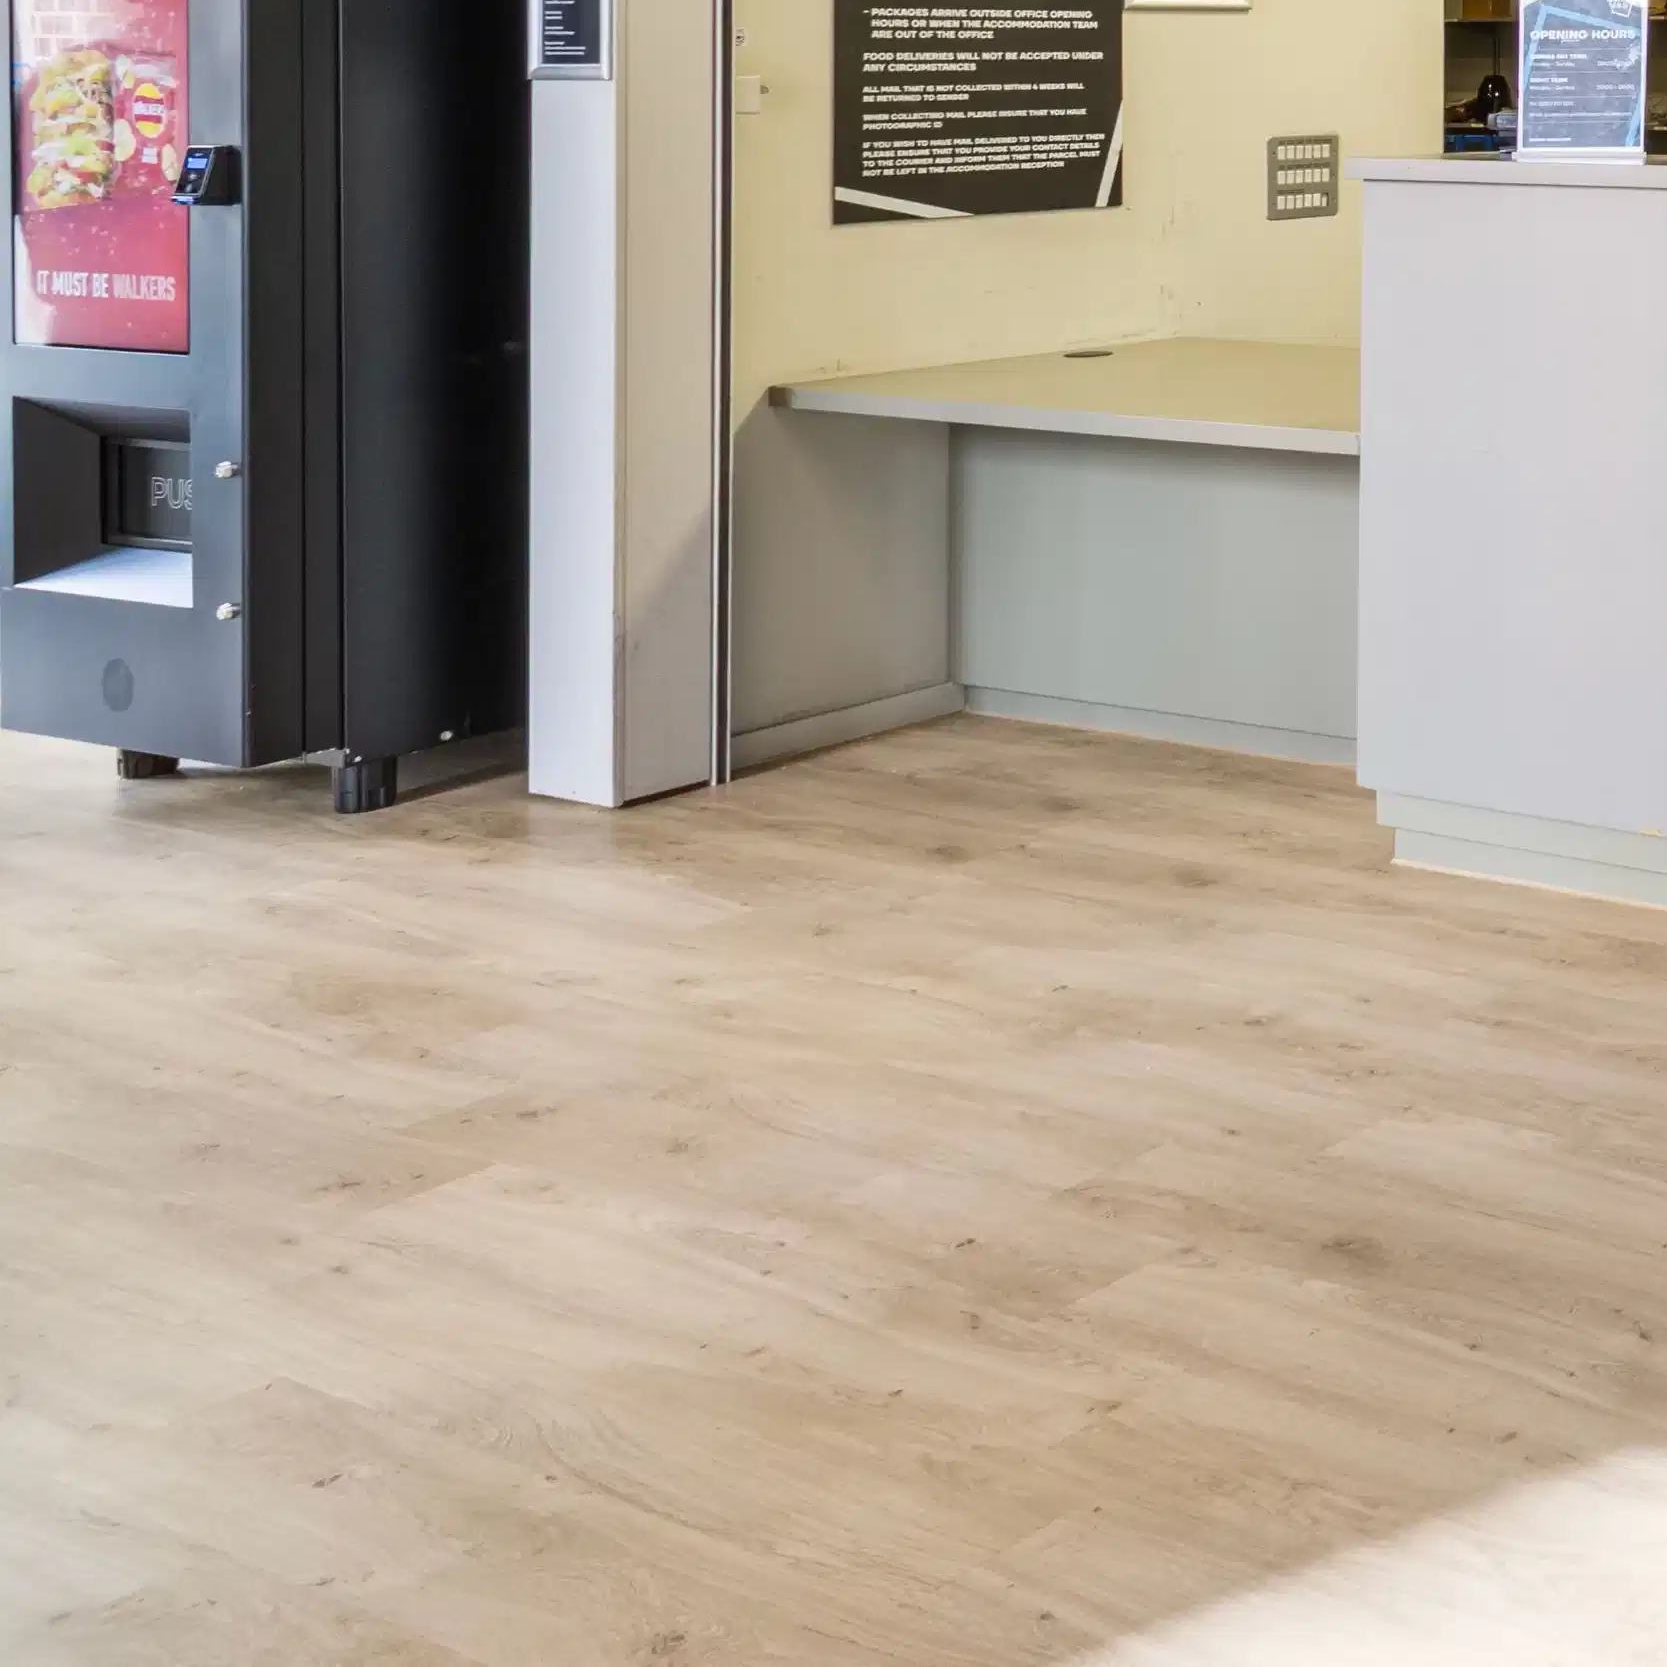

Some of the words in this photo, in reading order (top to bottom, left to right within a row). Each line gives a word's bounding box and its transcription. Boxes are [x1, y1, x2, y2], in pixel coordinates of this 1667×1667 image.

[1530, 30, 1588, 40] OPENING
[1592, 30, 1636, 40] HOURS
[36, 270, 49, 295] IT
[52, 271, 89, 297] MUST
[92, 272, 109, 298] BE
[112, 273, 176, 302] WALKERS
